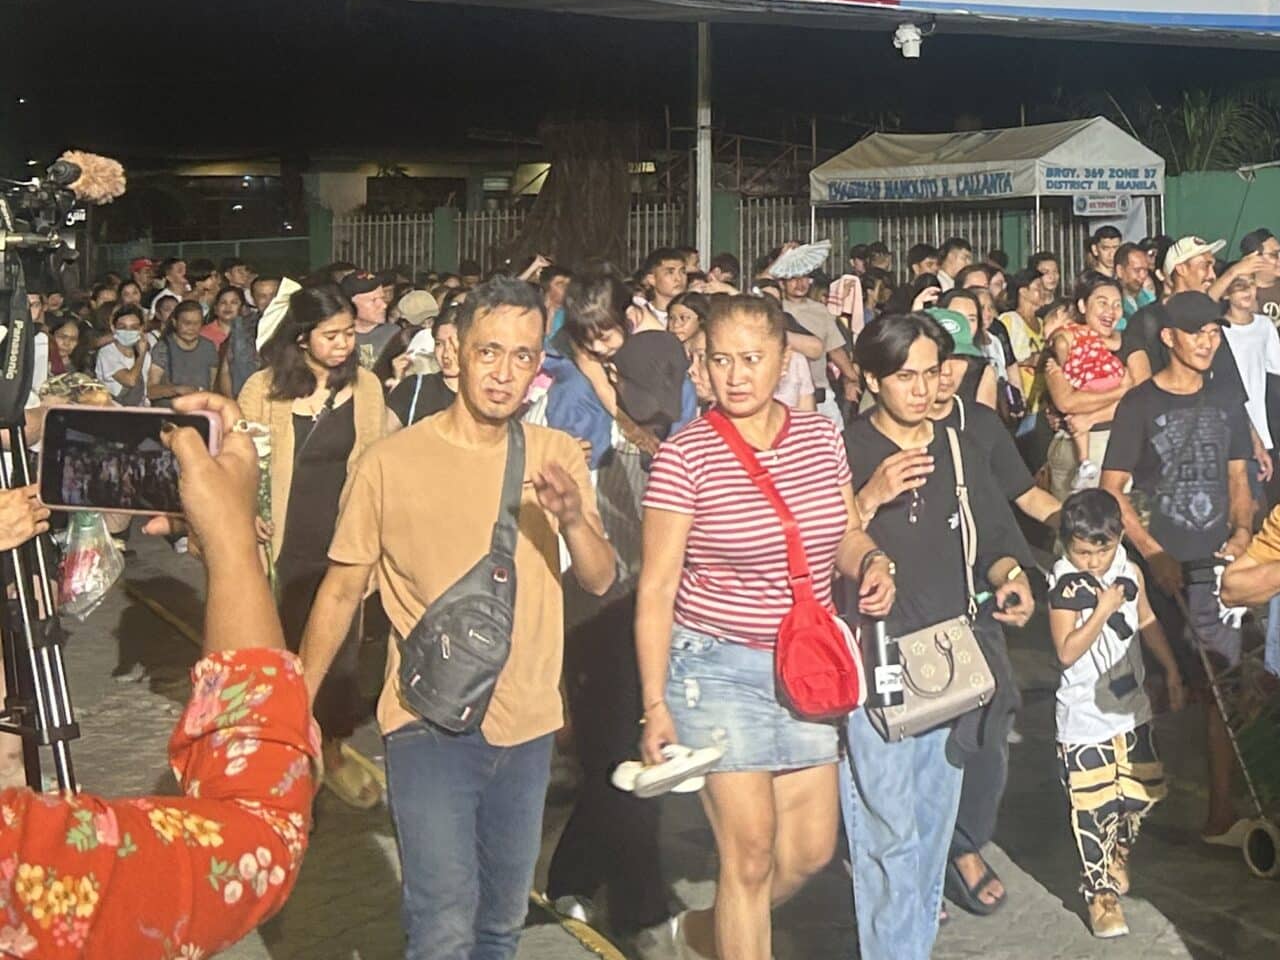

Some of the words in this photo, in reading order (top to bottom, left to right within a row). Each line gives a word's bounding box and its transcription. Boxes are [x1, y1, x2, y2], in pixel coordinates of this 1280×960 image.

[1108, 167, 1139, 179] ZONE
[1046, 180, 1094, 190] DISTRICT
[1115, 180, 1158, 190] MANILA
[6, 319, 24, 380] Panasonic
